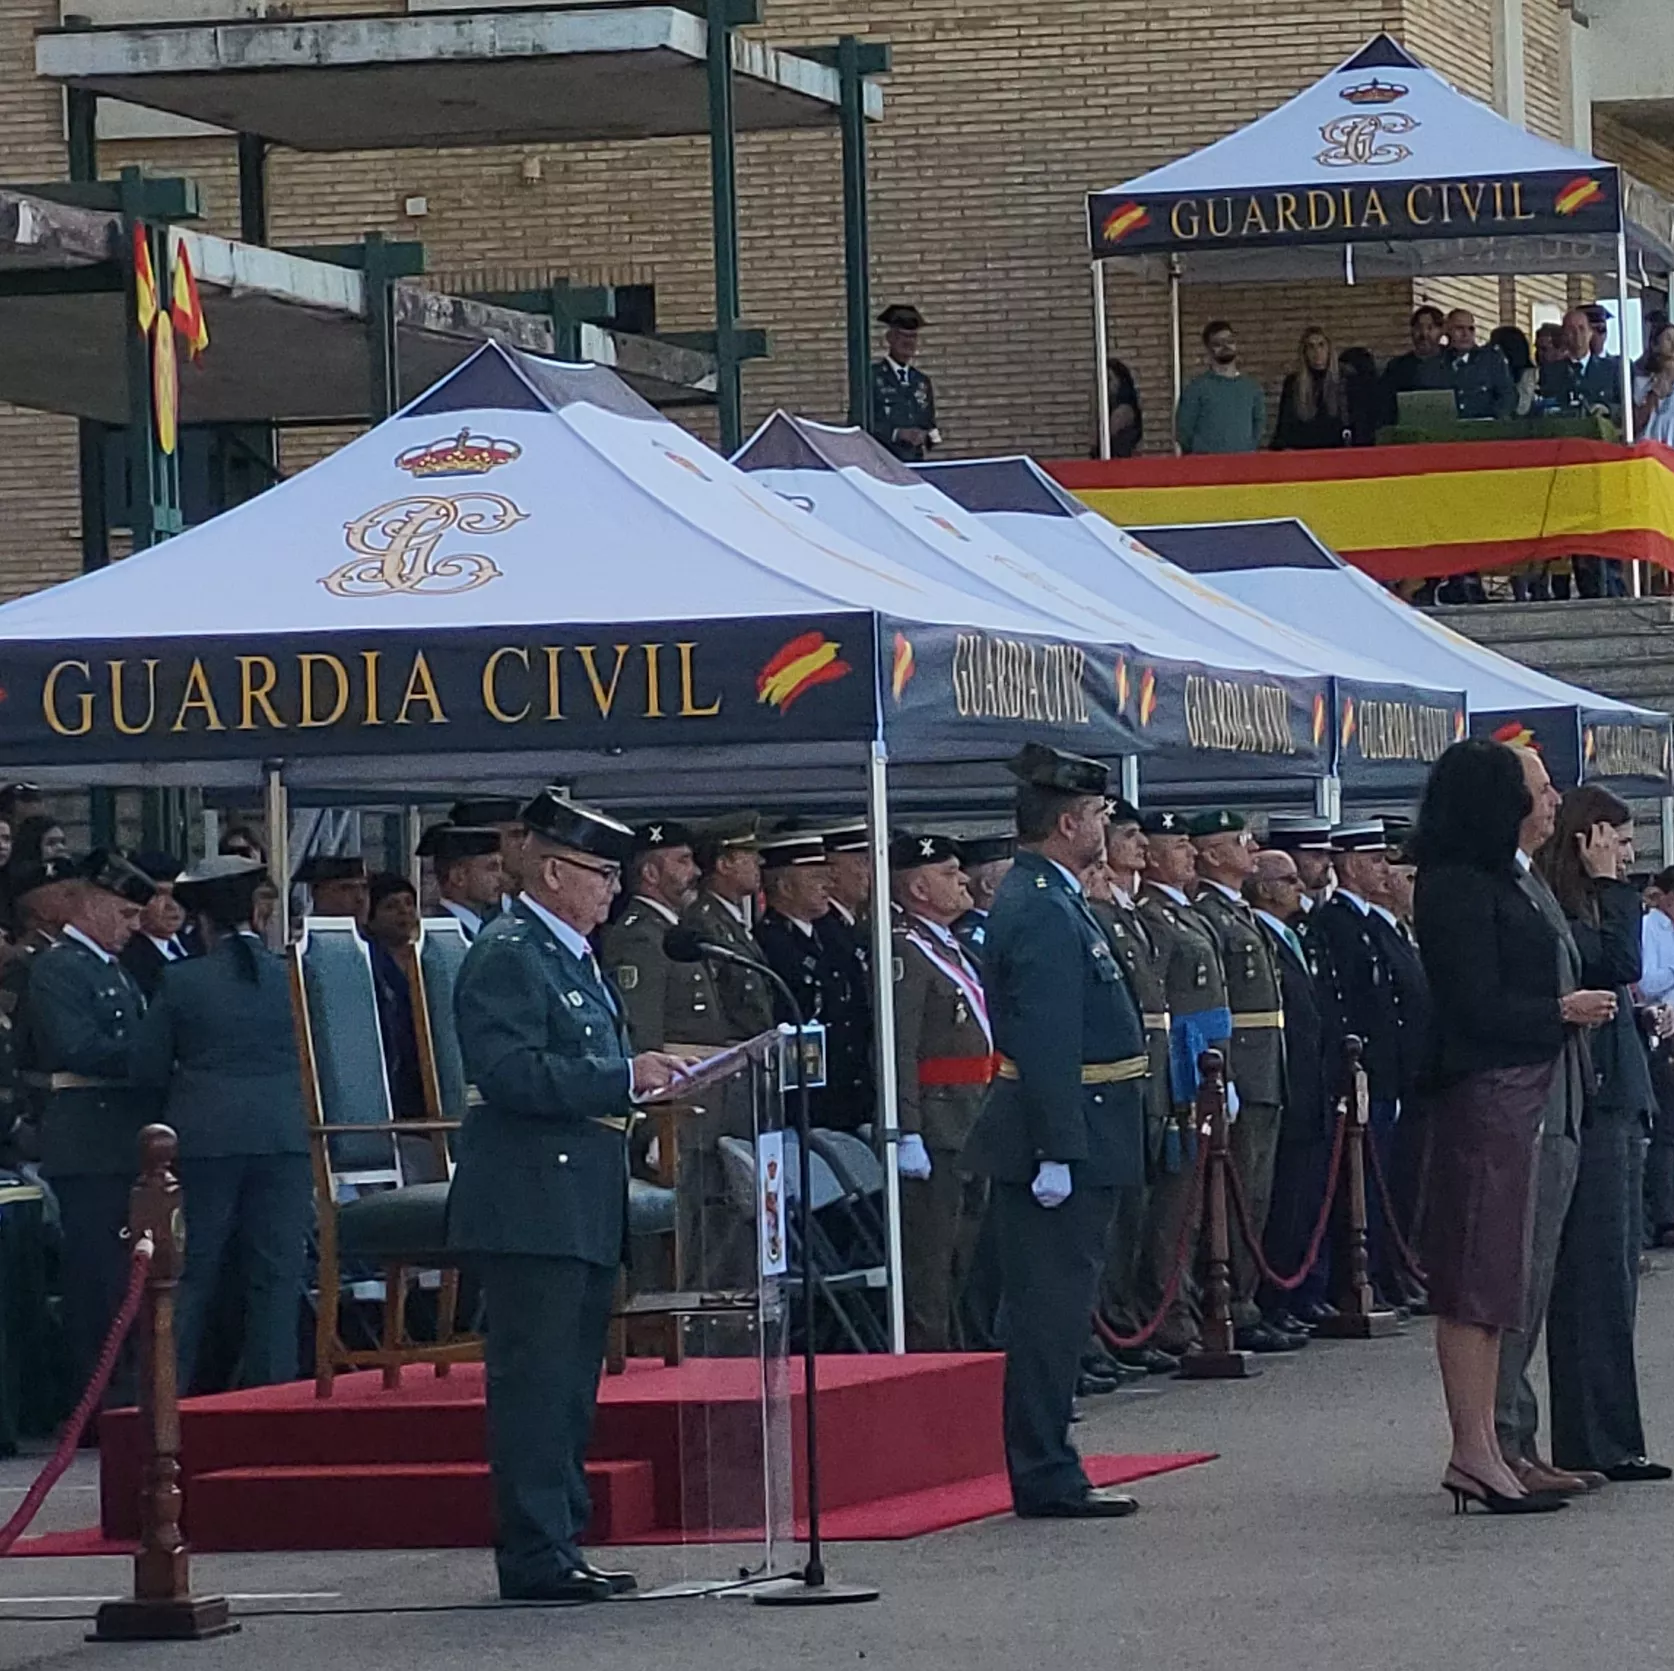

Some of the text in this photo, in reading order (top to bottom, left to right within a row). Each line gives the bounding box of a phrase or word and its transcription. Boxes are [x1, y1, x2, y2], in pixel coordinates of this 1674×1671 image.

[1170, 181, 1535, 239] GUARDIA CIVIL
[42, 642, 723, 737] GUARDIA CIVIL
[952, 634, 1089, 724] GUARDIA CIVIL
[1184, 674, 1296, 754] GUARDIA CIVIL
[1359, 700, 1418, 759] GUARDIA
